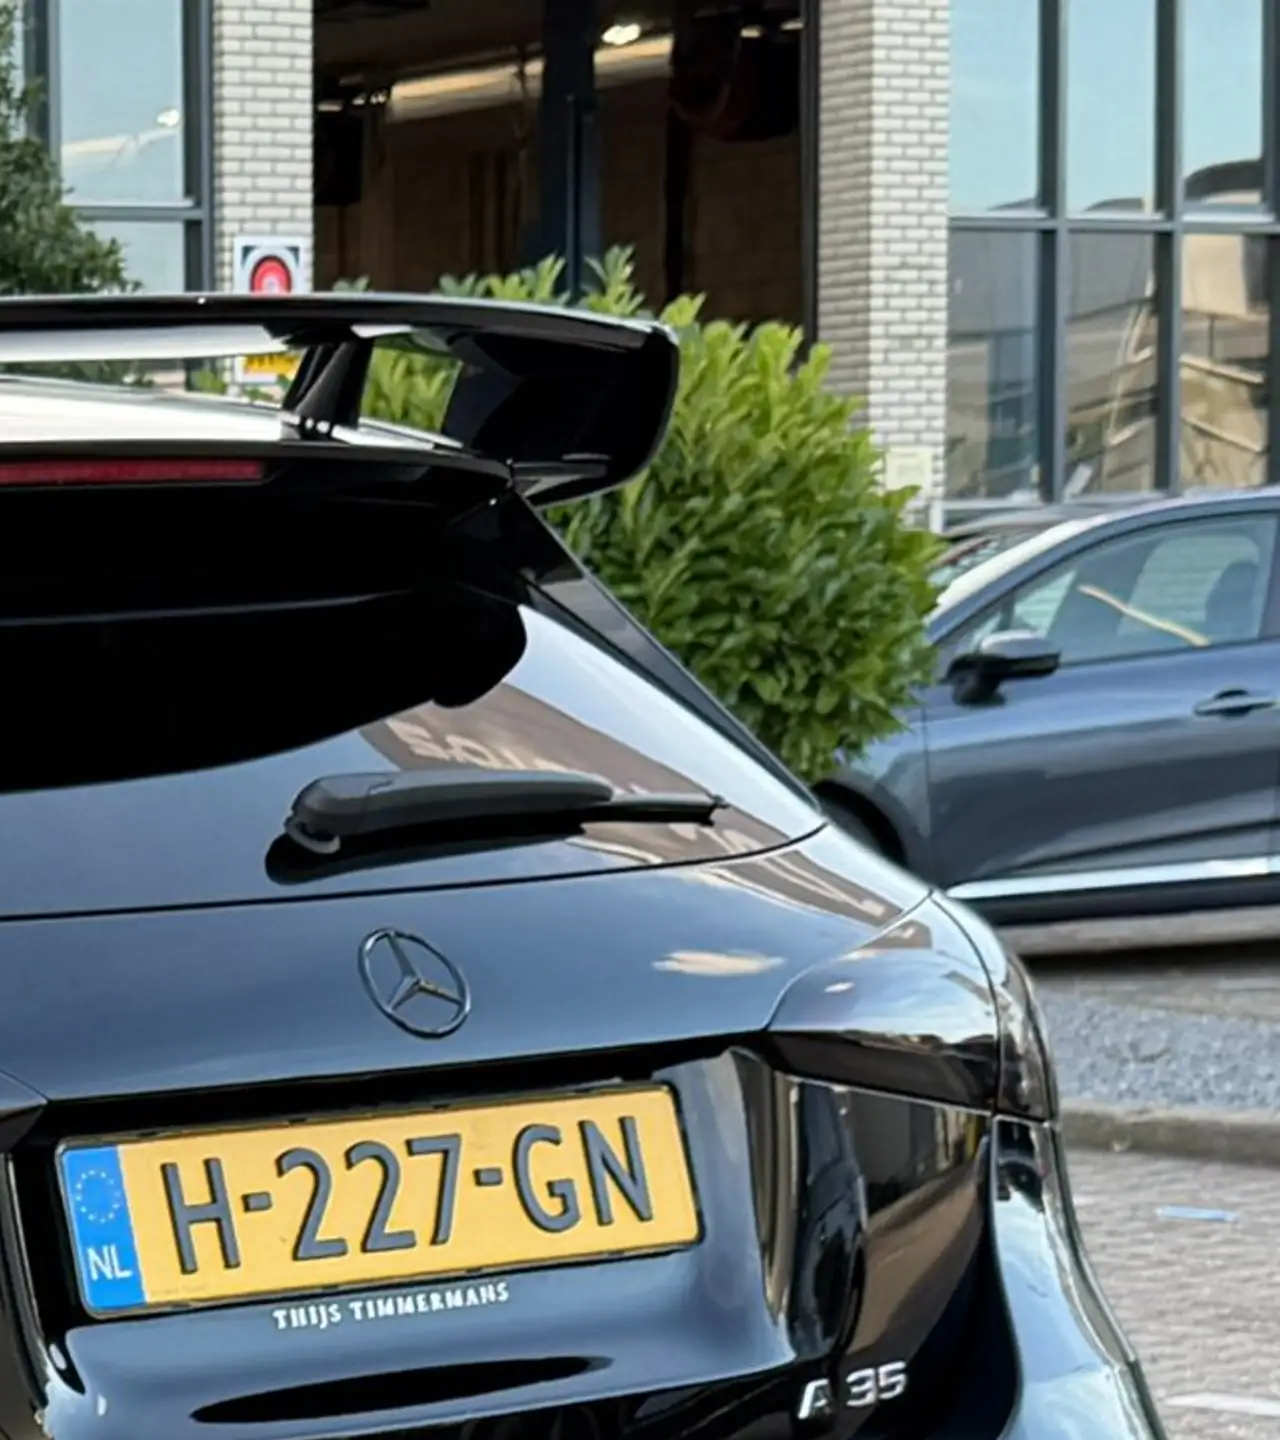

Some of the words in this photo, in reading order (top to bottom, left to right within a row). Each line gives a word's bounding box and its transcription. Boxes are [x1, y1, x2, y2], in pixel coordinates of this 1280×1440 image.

[160, 1115, 655, 1276] H-227-GN
[87, 1245, 133, 1282] NL
[272, 1302, 343, 1330] THIJS
[348, 1281, 510, 1321] TIMMERMANS
[797, 1378, 832, 1420] A
[845, 1361, 908, 1407] 35
